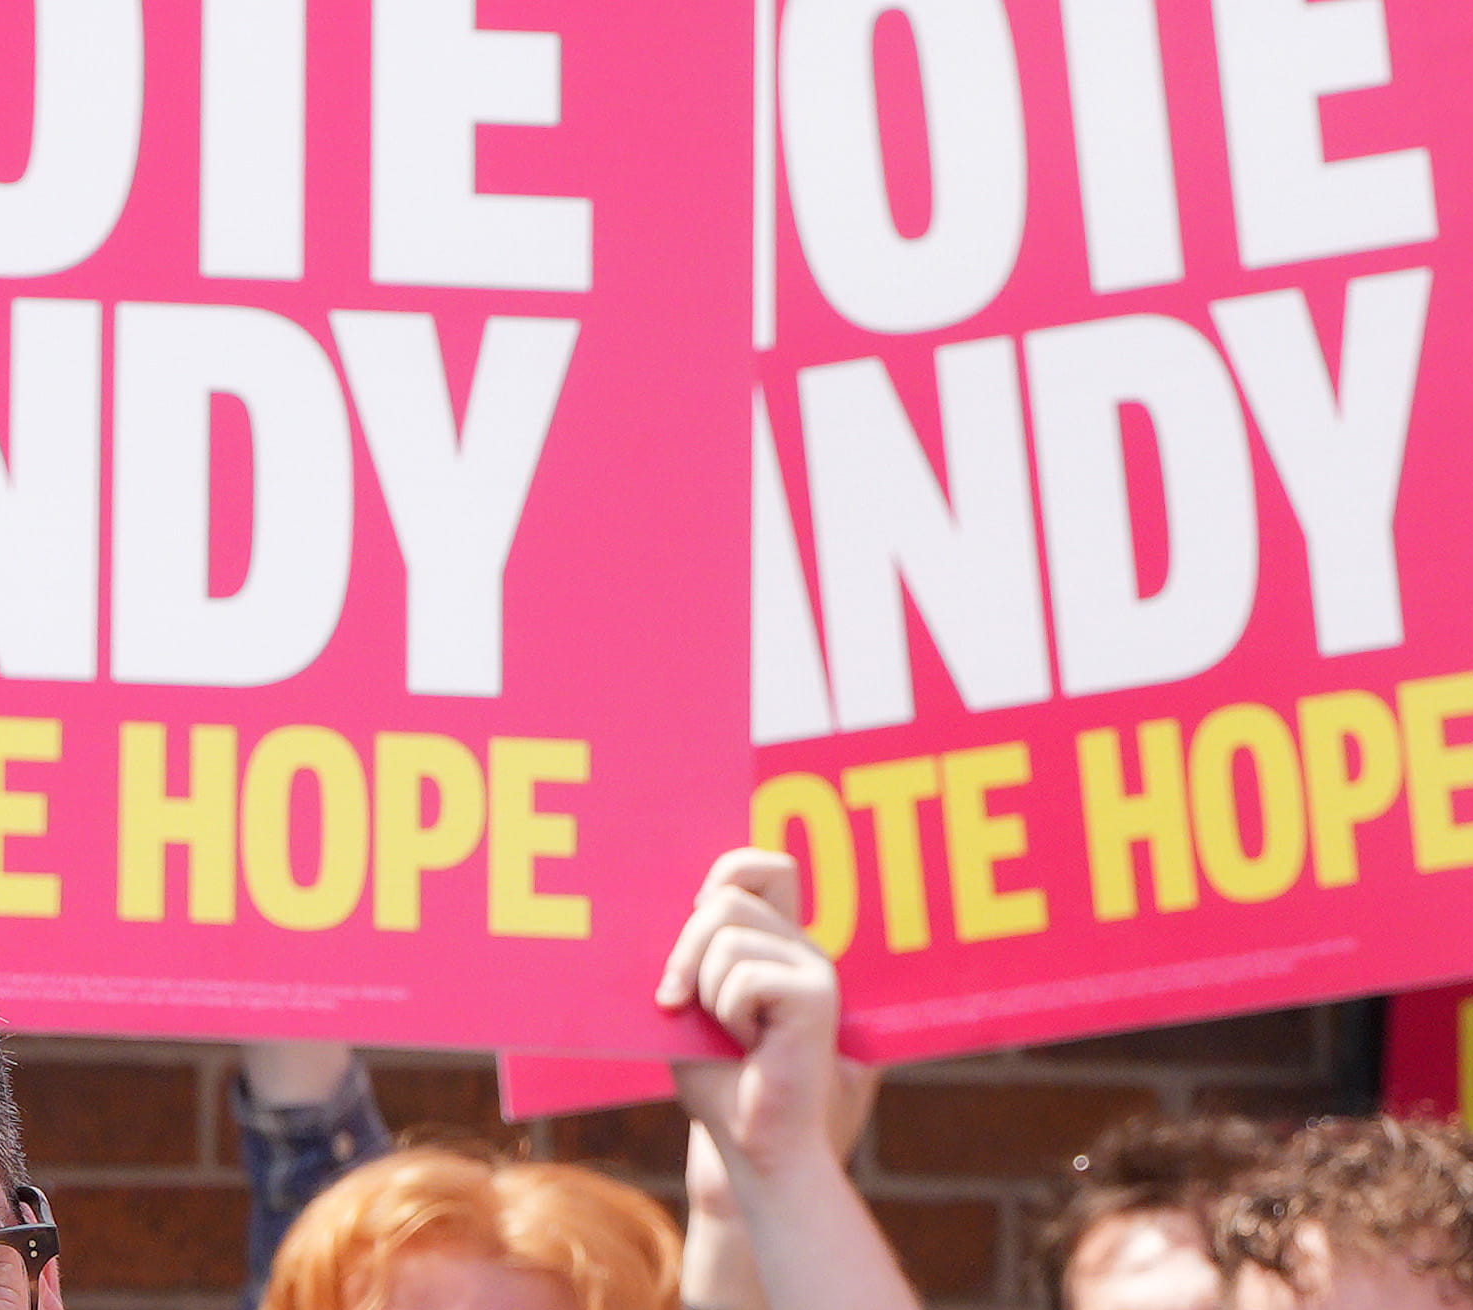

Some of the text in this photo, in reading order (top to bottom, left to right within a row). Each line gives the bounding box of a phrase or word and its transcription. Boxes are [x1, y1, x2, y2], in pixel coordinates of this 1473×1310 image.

[753, 0, 1439, 350] OTE
[117, 714, 592, 940] HOPE
[751, 742, 1048, 962] OTE
